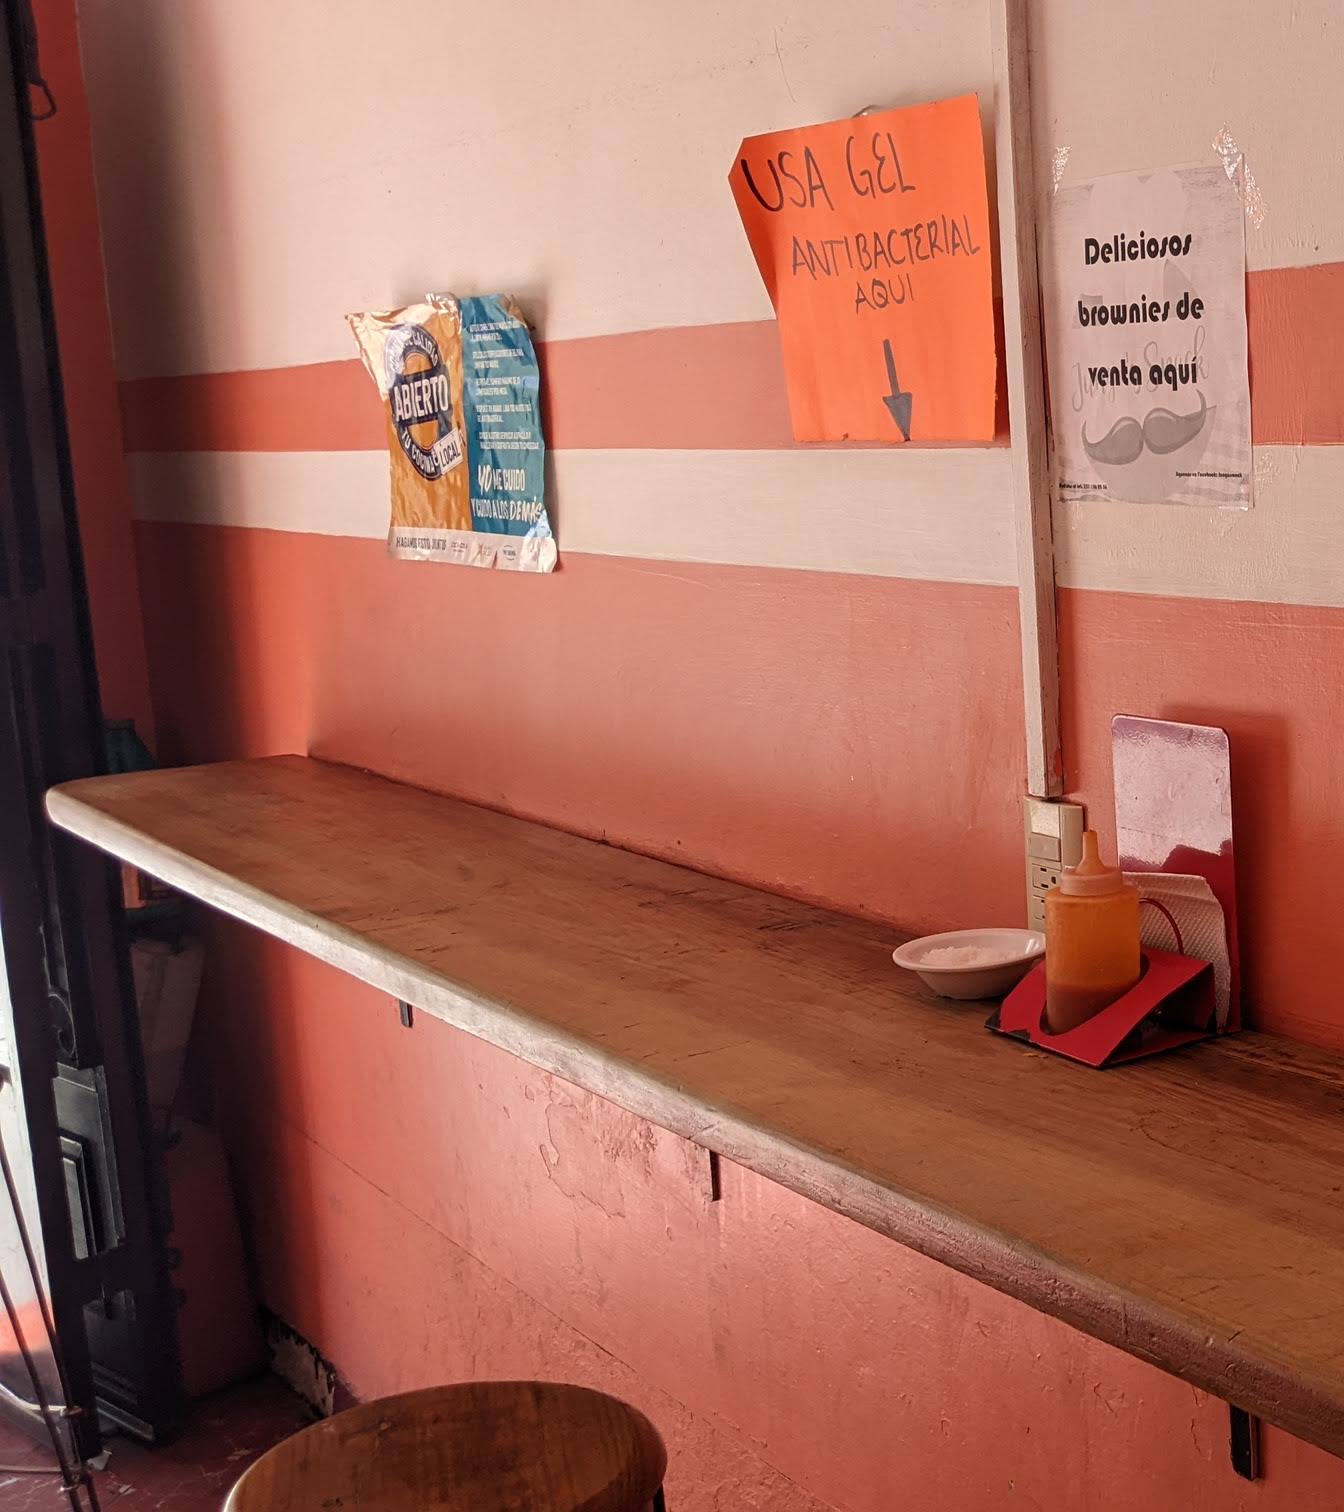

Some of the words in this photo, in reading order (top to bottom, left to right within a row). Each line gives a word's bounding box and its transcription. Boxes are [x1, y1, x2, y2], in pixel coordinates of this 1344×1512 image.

[741, 147, 834, 212] USA
[846, 133, 916, 199] GEL
[792, 215, 981, 280] ANTIBACTERIAL
[1084, 231, 1192, 265] Deliciosos
[855, 274, 914, 314] AQUI
[1078, 295, 1170, 326] brownies
[1176, 292, 1204, 320] de
[1088, 359, 1142, 386] venta
[1149, 359, 1198, 391] aquí
[394, 375, 448, 422] ABIERTO
[402, 427, 411, 448] TU
[440, 441, 460, 467] LOCAL
[478, 464, 492, 496] YO
[493, 469, 502, 490] ME
[503, 469, 525, 491] CUIDO
[492, 500, 497, 518] A
